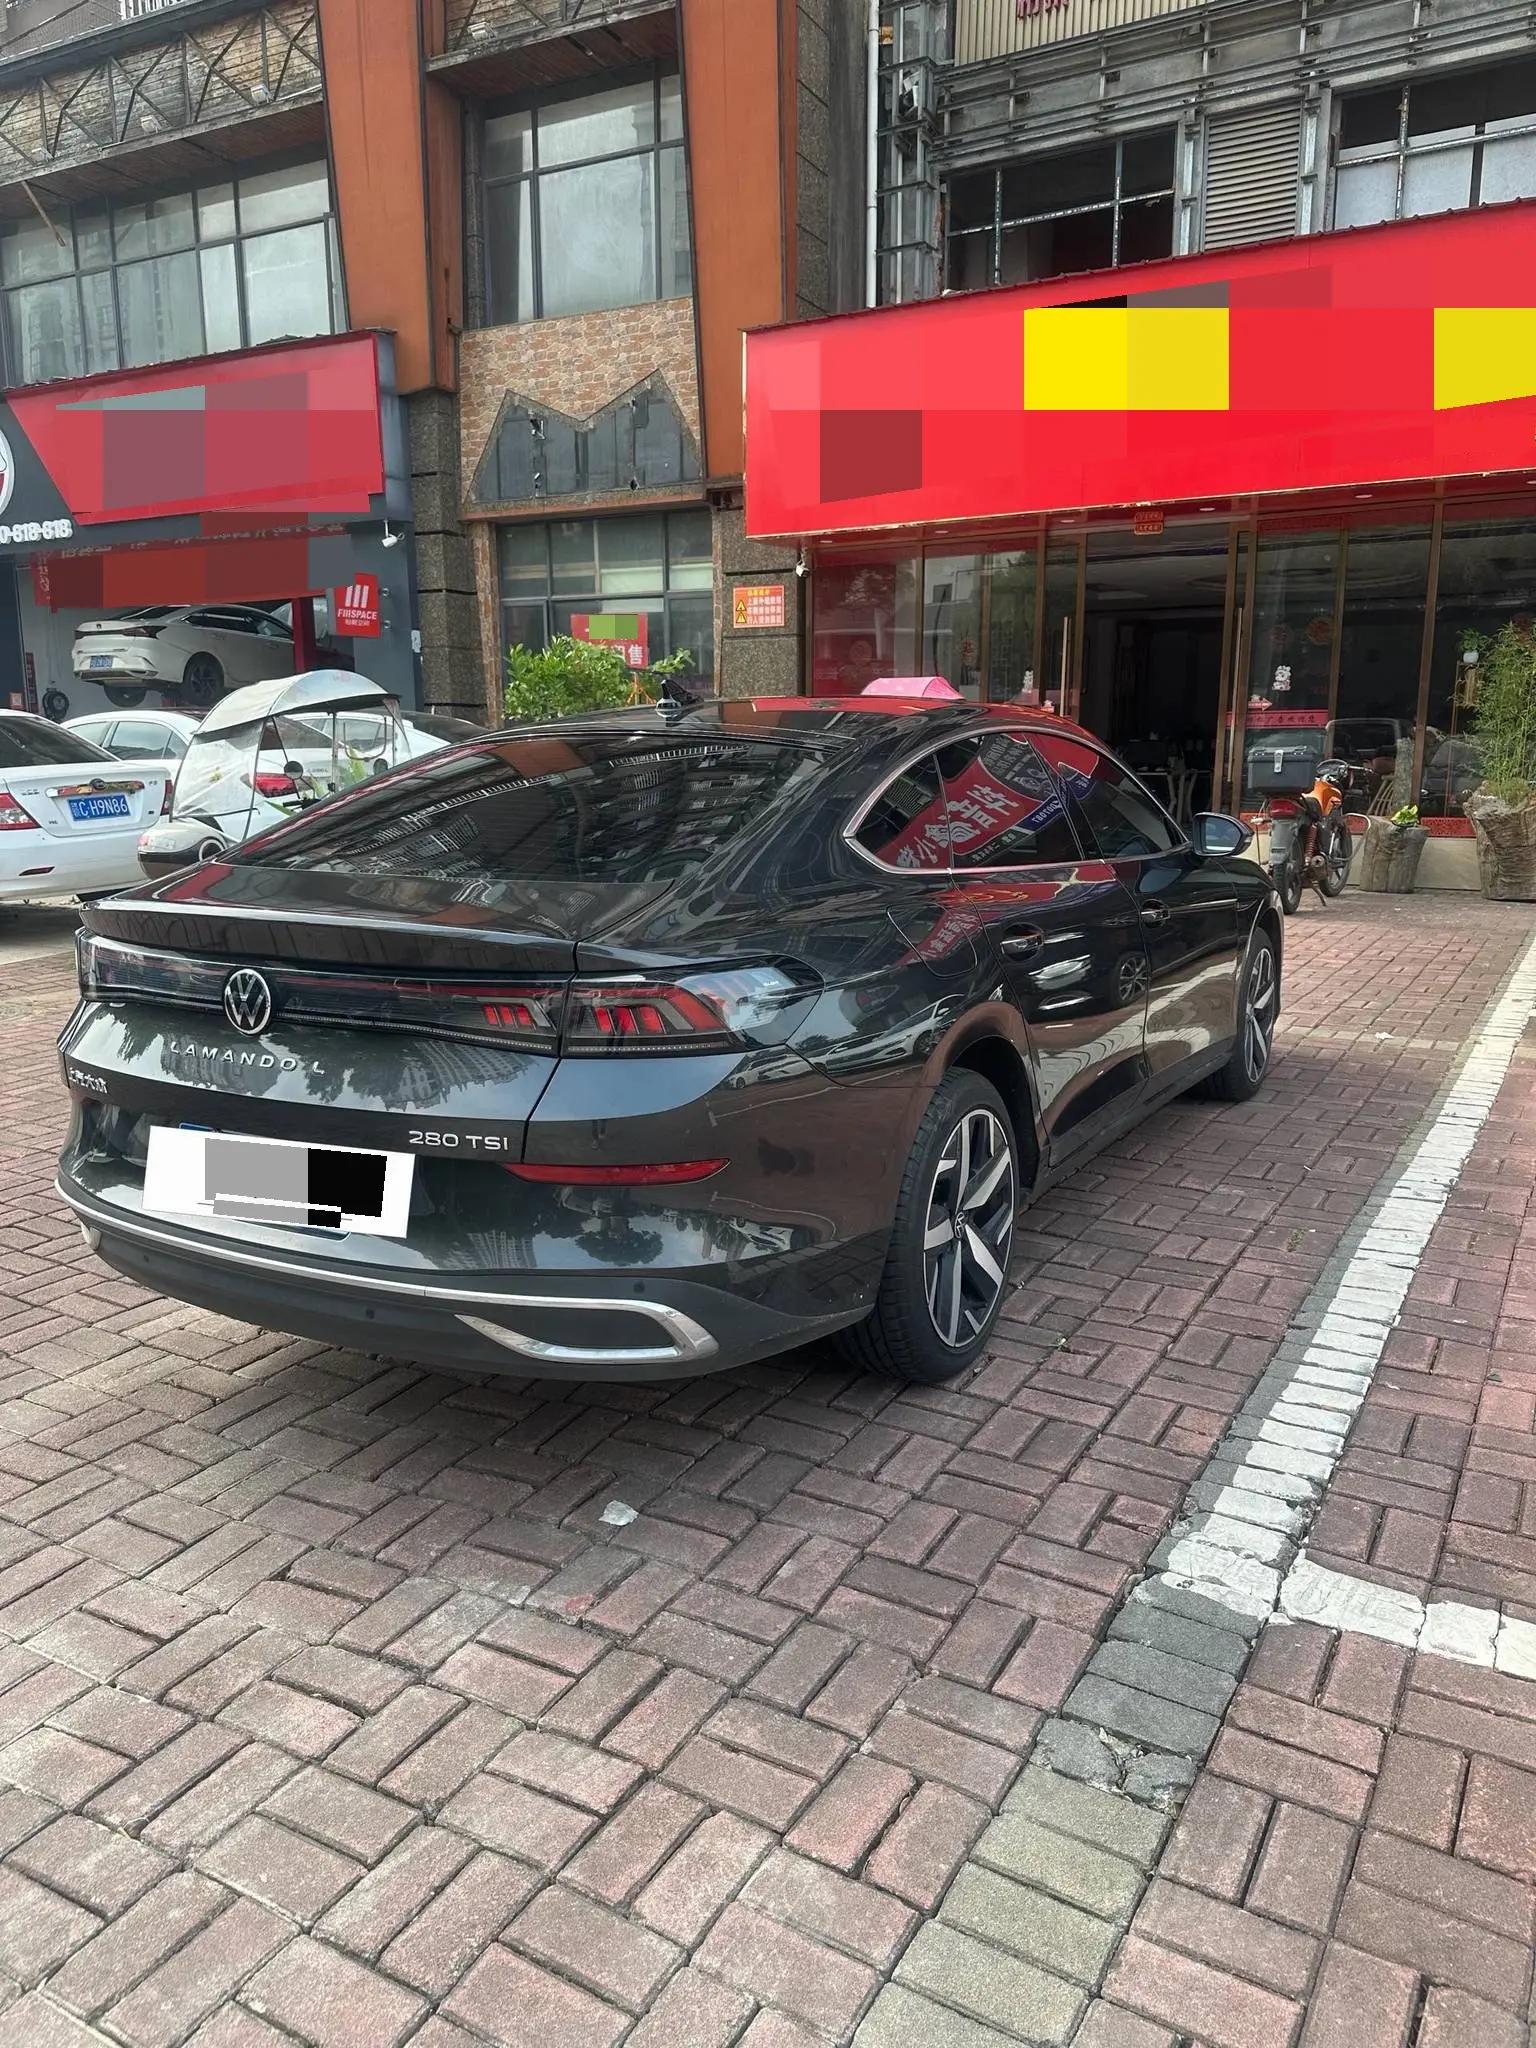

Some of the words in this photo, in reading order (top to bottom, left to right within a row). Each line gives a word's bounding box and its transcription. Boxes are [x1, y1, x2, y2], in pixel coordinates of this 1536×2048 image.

[170, 1041, 297, 1071] LAMANDO
[312, 1061, 325, 1075] L
[408, 1130, 459, 1148] 280
[465, 1135, 509, 1151] TSI
